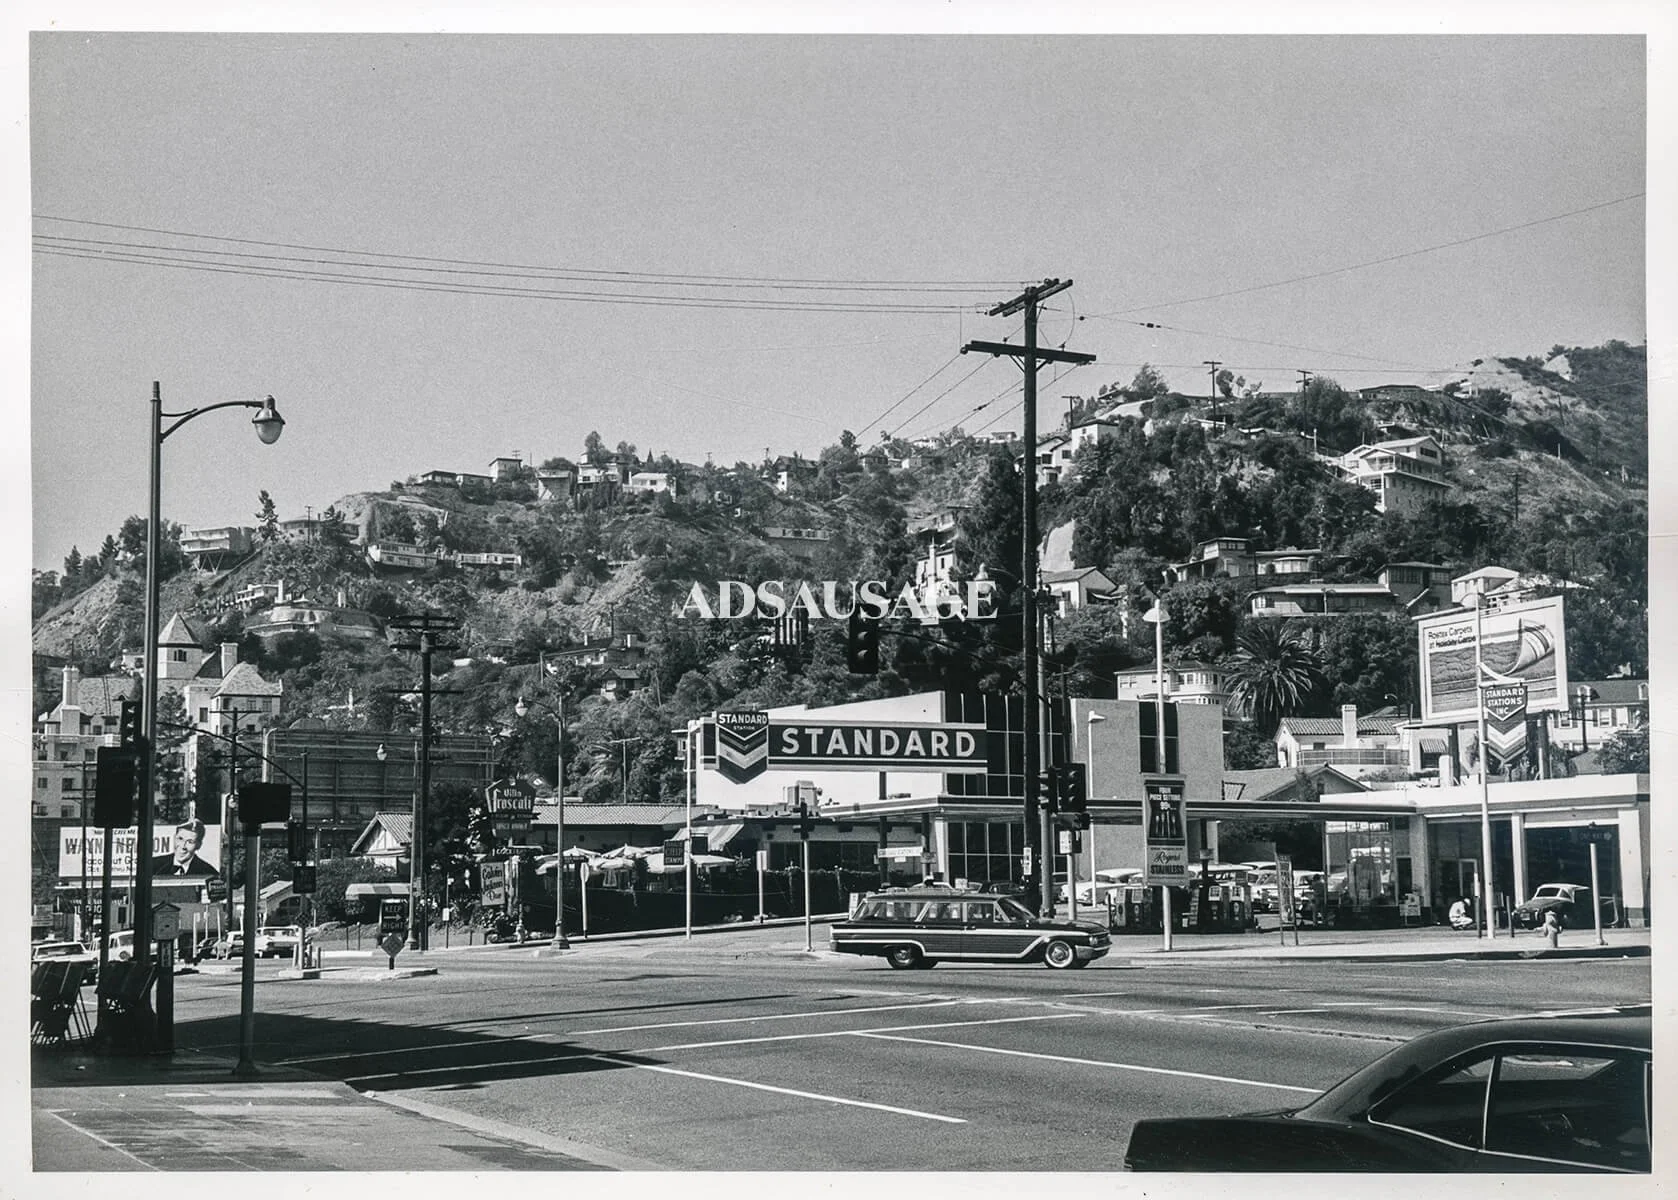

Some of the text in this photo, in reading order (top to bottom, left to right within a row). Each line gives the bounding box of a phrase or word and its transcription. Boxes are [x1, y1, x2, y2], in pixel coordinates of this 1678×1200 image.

[1486, 688, 1525, 699] STANDARD
[1487, 697, 1523, 707] STATIONS
[719, 713, 768, 724] STANDARD
[782, 727, 976, 758] STANDARD
[1151, 865, 1185, 874] STAINLESS
[385, 904, 402, 912] KEEP
[383, 921, 404, 930] RIGHT
